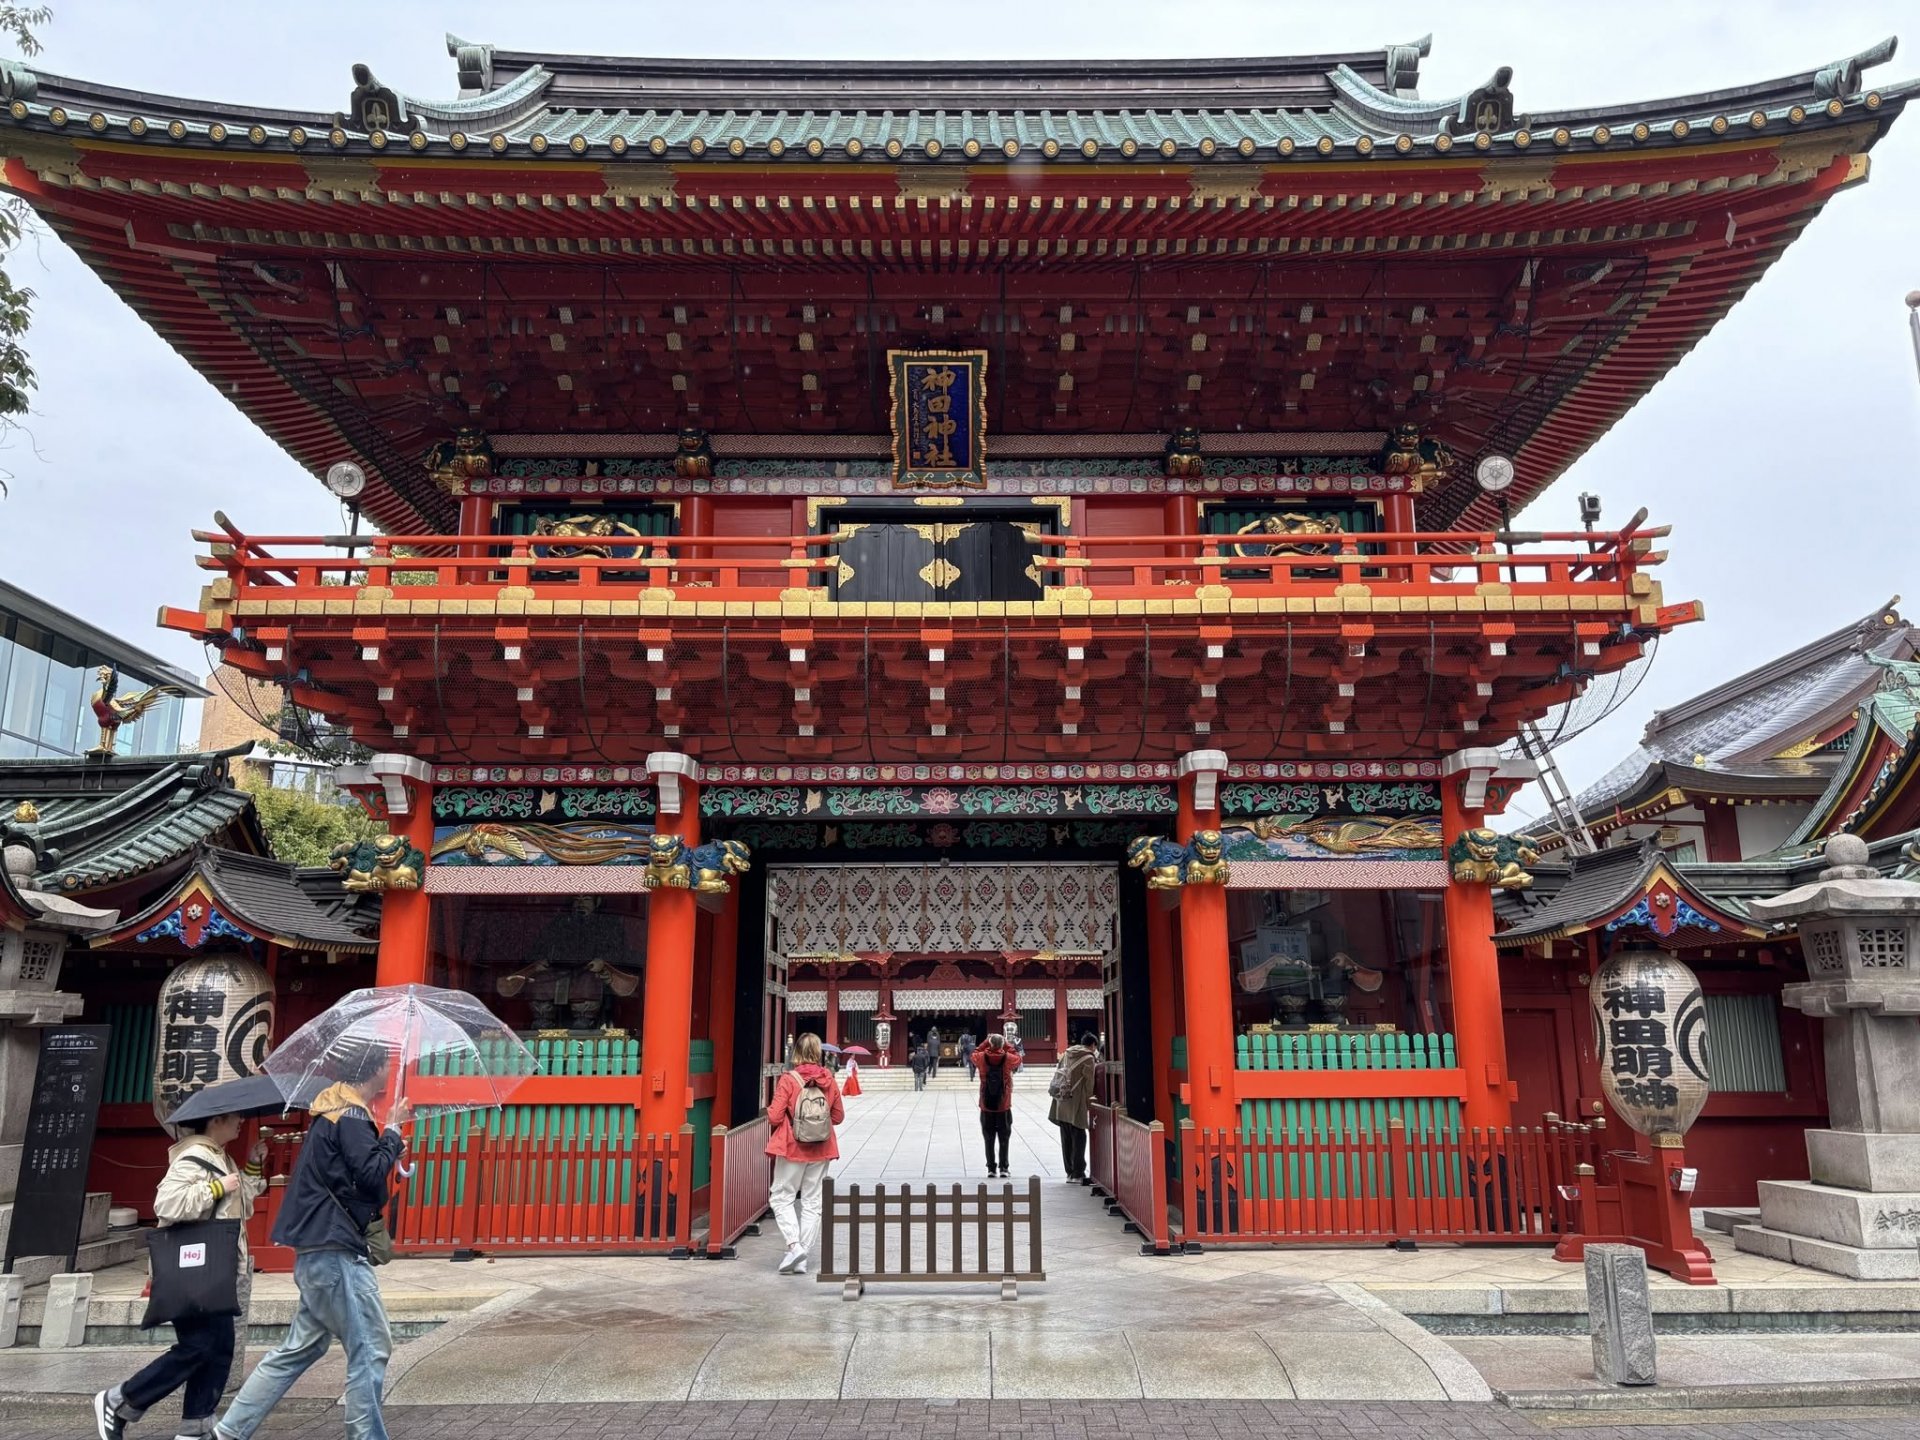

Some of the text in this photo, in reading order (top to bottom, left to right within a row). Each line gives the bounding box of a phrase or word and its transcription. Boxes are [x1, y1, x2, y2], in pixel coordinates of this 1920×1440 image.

[921, 365, 957, 467] 神田神社
[1602, 979, 1680, 1110] 神田明神
[184, 1251, 201, 1261] Hej
